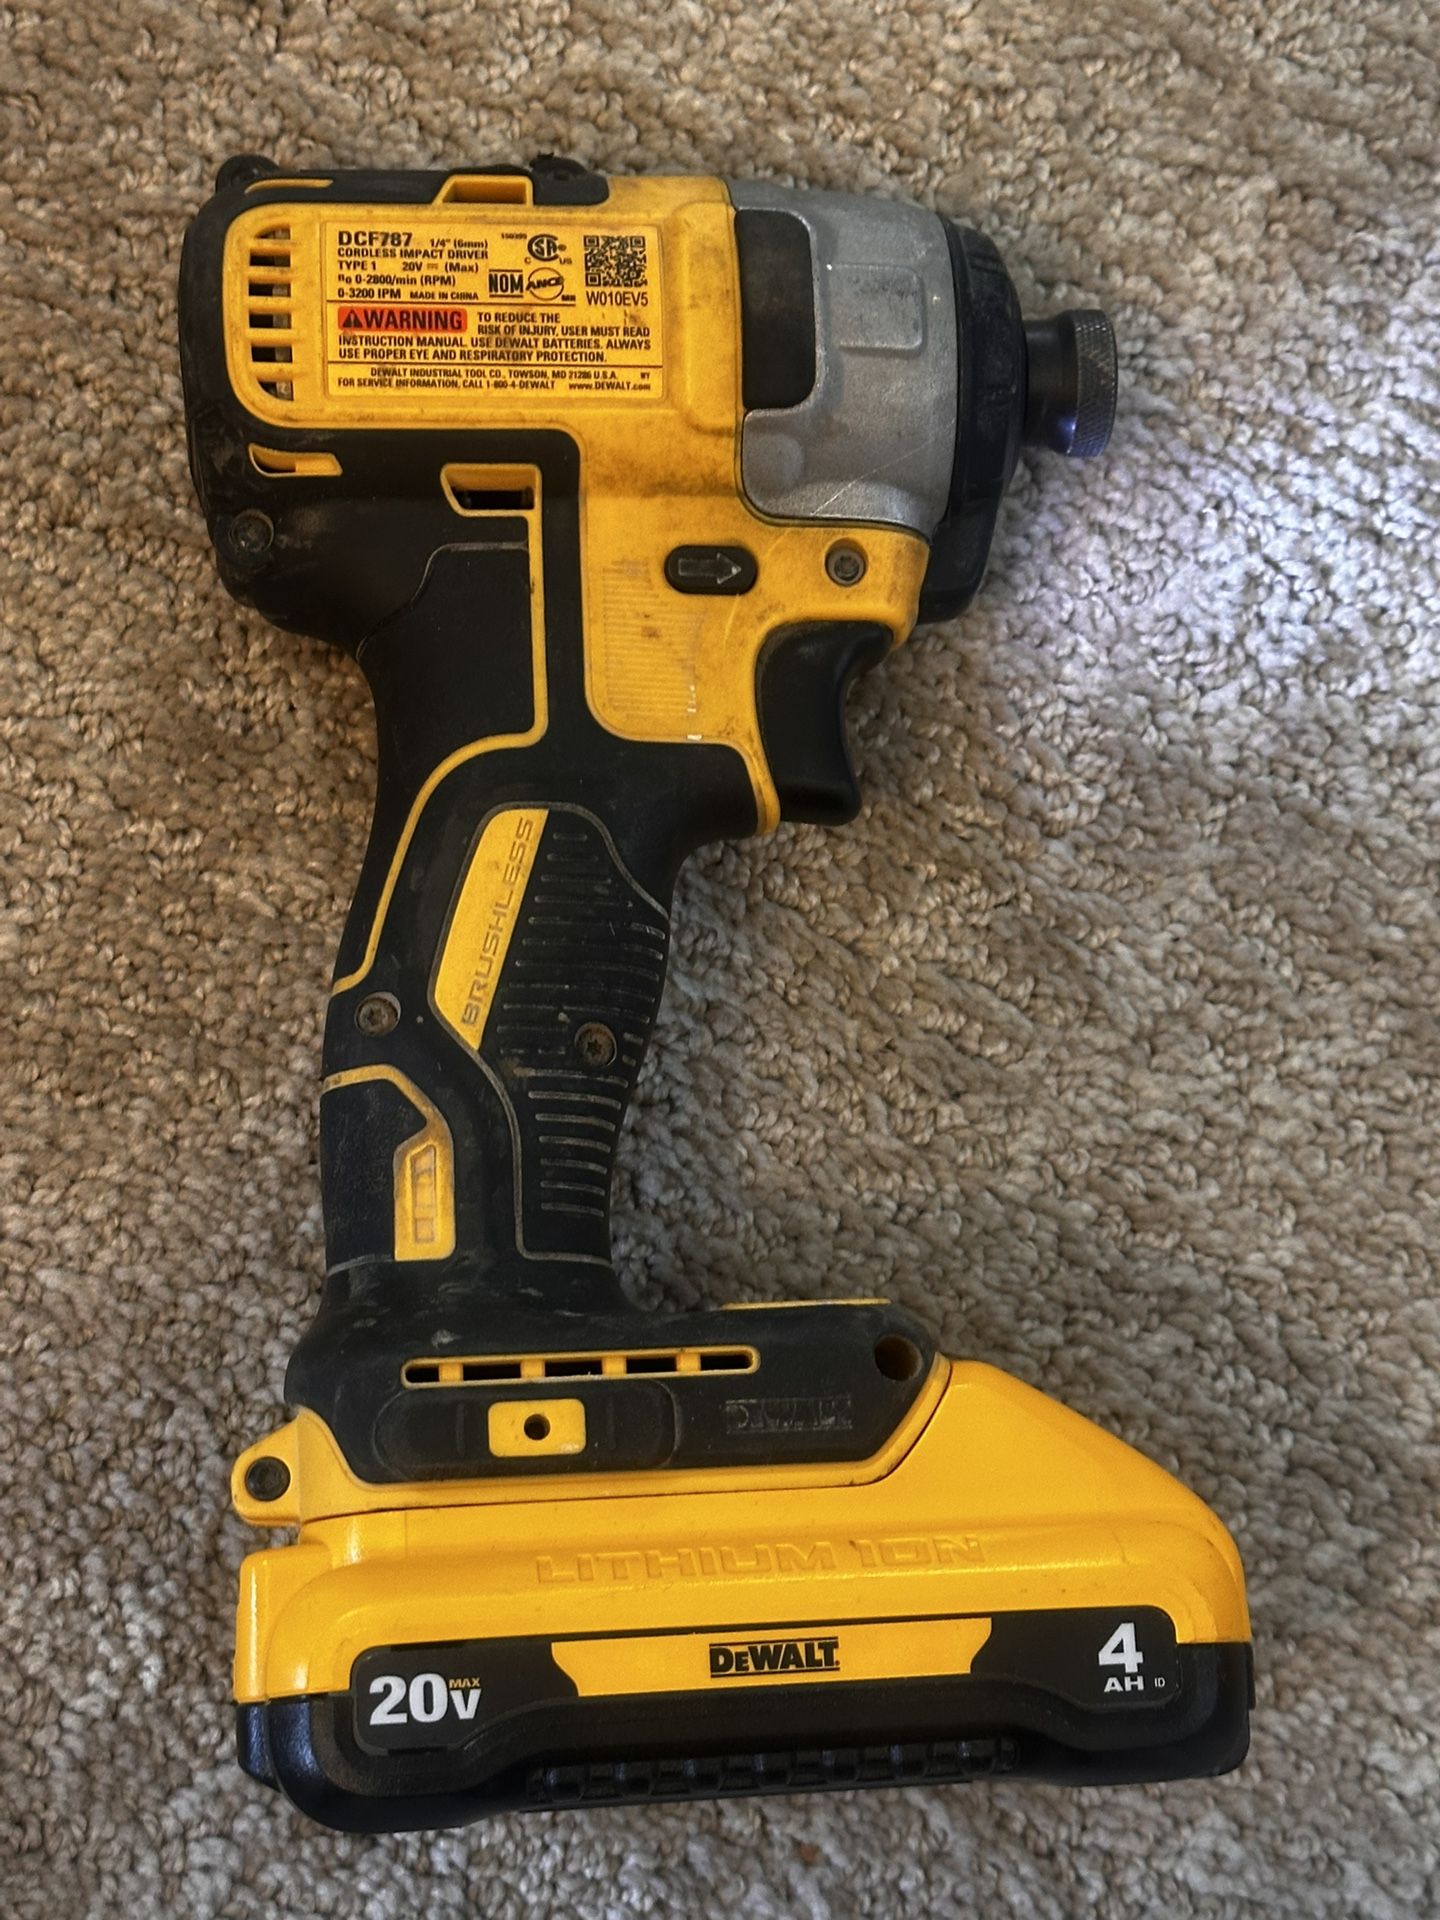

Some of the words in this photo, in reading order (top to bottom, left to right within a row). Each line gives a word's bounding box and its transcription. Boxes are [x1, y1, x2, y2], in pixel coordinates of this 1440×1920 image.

[338, 231, 412, 246] DCF787
[454, 239, 488, 250] (6mm)
[338, 248, 396, 258] CORDLESS
[400, 249, 443, 259] IMPACT
[448, 250, 488, 260] DRIVER
[338, 261, 368, 270] TYPE
[371, 261, 376, 270] 1
[402, 262, 422, 272] 20V
[445, 262, 478, 273] (Max)
[355, 274, 416, 286] 0-2800/min
[420, 275, 456, 286] (RPM)
[488, 273, 524, 293] NOM
[338, 288, 374, 298] 0-3200
[378, 289, 401, 299] IPM
[410, 292, 436, 300] MADE
[438, 292, 448, 300] IN
[450, 292, 479, 300] CHINA
[586, 291, 648, 306] W010EV5
[363, 310, 462, 330] WARNING
[478, 312, 492, 322] TO
[494, 312, 537, 324] REDUCE
[540, 313, 561, 324] THE
[478, 324, 500, 335] RISK
[504, 325, 516, 336] OF
[562, 326, 588, 336] USER
[590, 326, 620, 336] MUST
[623, 326, 650, 337] READ
[339, 335, 414, 346] INSTRUCTION
[471, 338, 492, 348] USE
[495, 338, 539, 348] DEWALT
[606, 340, 651, 350] ALWAYS
[339, 348, 360, 359] USE
[364, 349, 407, 360] PROPER
[410, 350, 430, 360] EYE
[432, 350, 456, 360] AND
[460, 350, 534, 362] RESPIRATORY
[536, 351, 607, 362] PROTECTION.
[371, 368, 407, 378] DEWALT
[410, 368, 462, 378] INDUSTRIAL
[466, 369, 486, 378] TOOL
[552, 370, 566, 379] MD
[338, 378, 354, 387] FOR
[357, 378, 392, 388] SERVICE
[462, 379, 483, 388] CALL
[569, 381, 651, 390] www.DEWALT.com
[461, 817, 534, 1026] BRUSHLESS
[536, 1541, 837, 1583] LITHIUM
[849, 1536, 986, 1568] ION
[1098, 1622, 1144, 1674] 4
[710, 1640, 840, 1674] DEWALT
[449, 1678, 480, 1688] MAX
[1104, 1676, 1144, 1692] AH
[1154, 1677, 1166, 1688] ID
[369, 1673, 481, 1726] 20V
